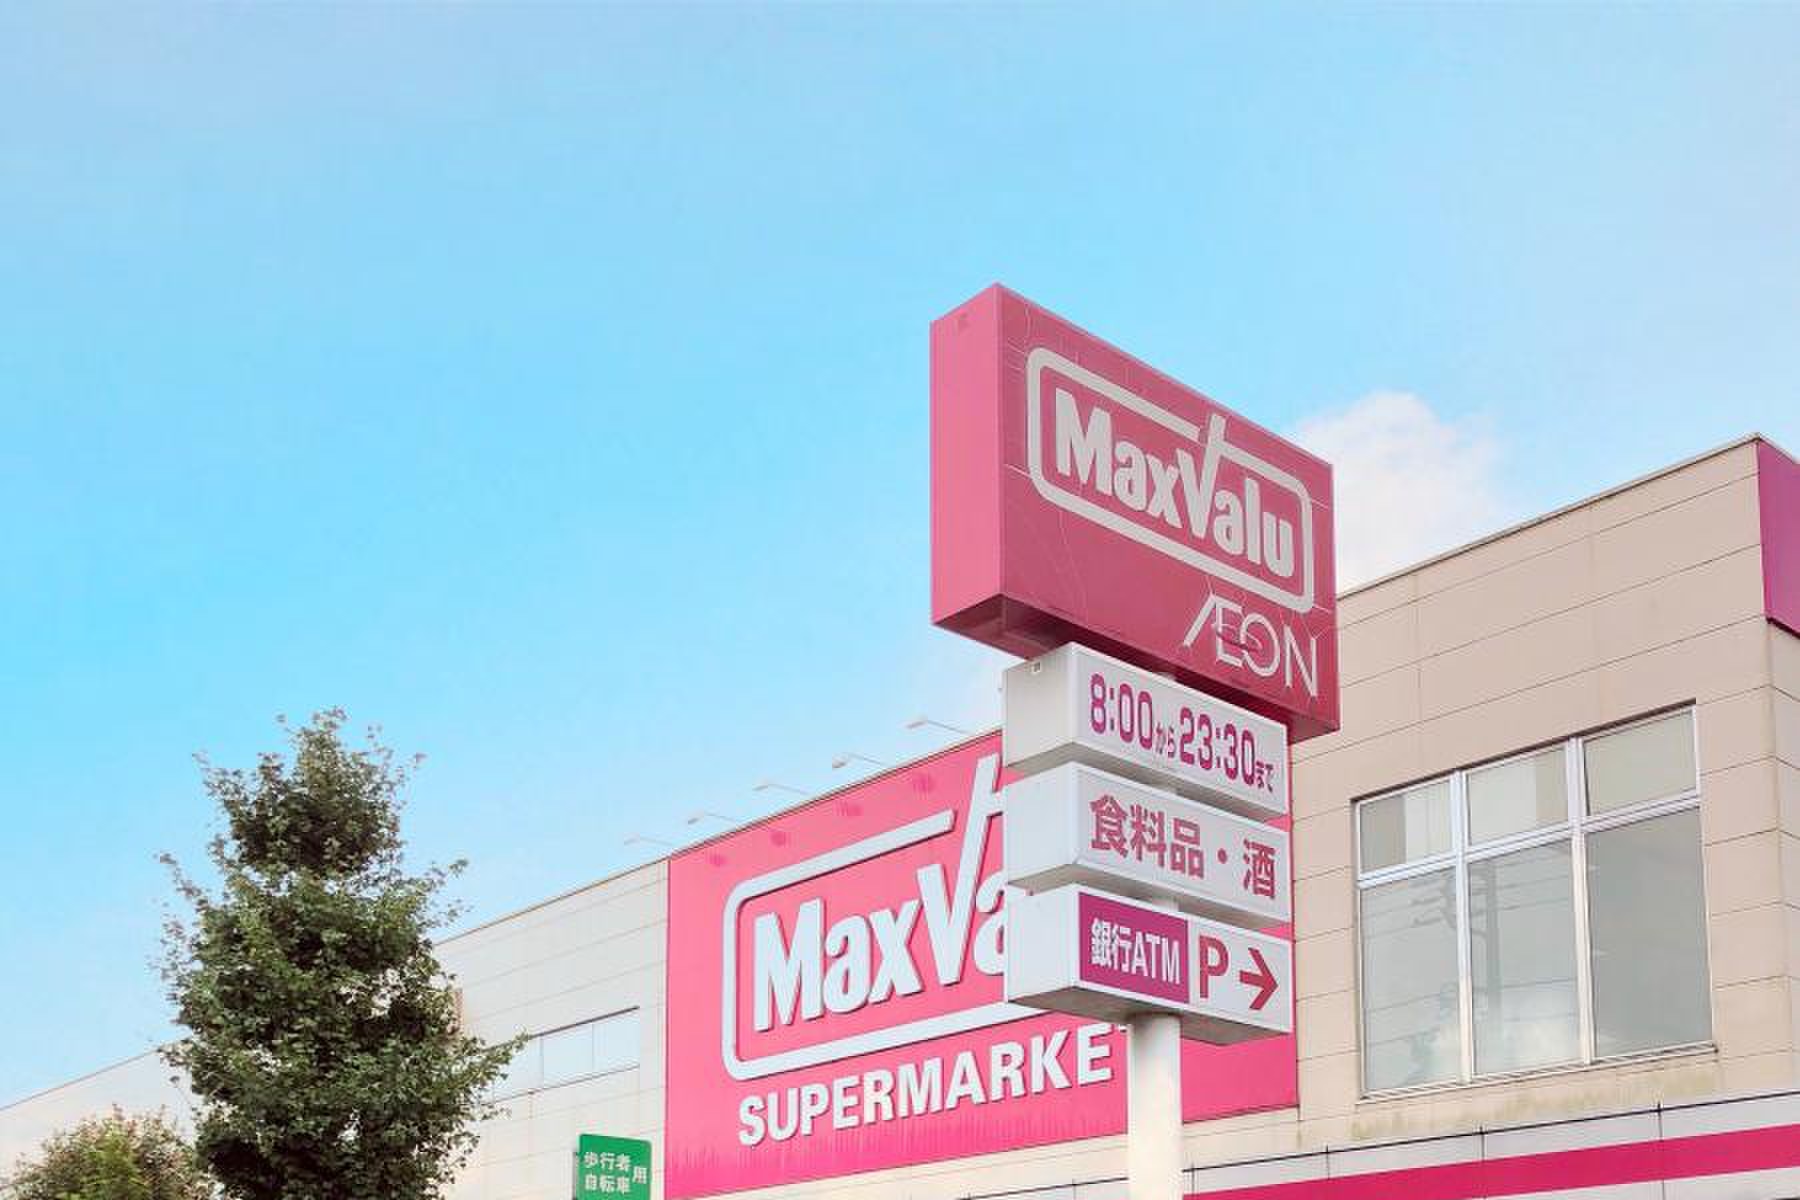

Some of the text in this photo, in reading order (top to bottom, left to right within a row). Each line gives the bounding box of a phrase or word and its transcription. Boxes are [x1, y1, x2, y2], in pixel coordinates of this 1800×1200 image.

[1055, 387, 1294, 577] MaxValu
[753, 753, 1007, 1033] MaxVa
[1090, 917, 1181, 985] 銀行ATM
[1199, 936, 1230, 999] P
[738, 1022, 1127, 1146] SUPERMARKE
[583, 1151, 631, 1172] 歩行者
[584, 1173, 631, 1194] 自転車
